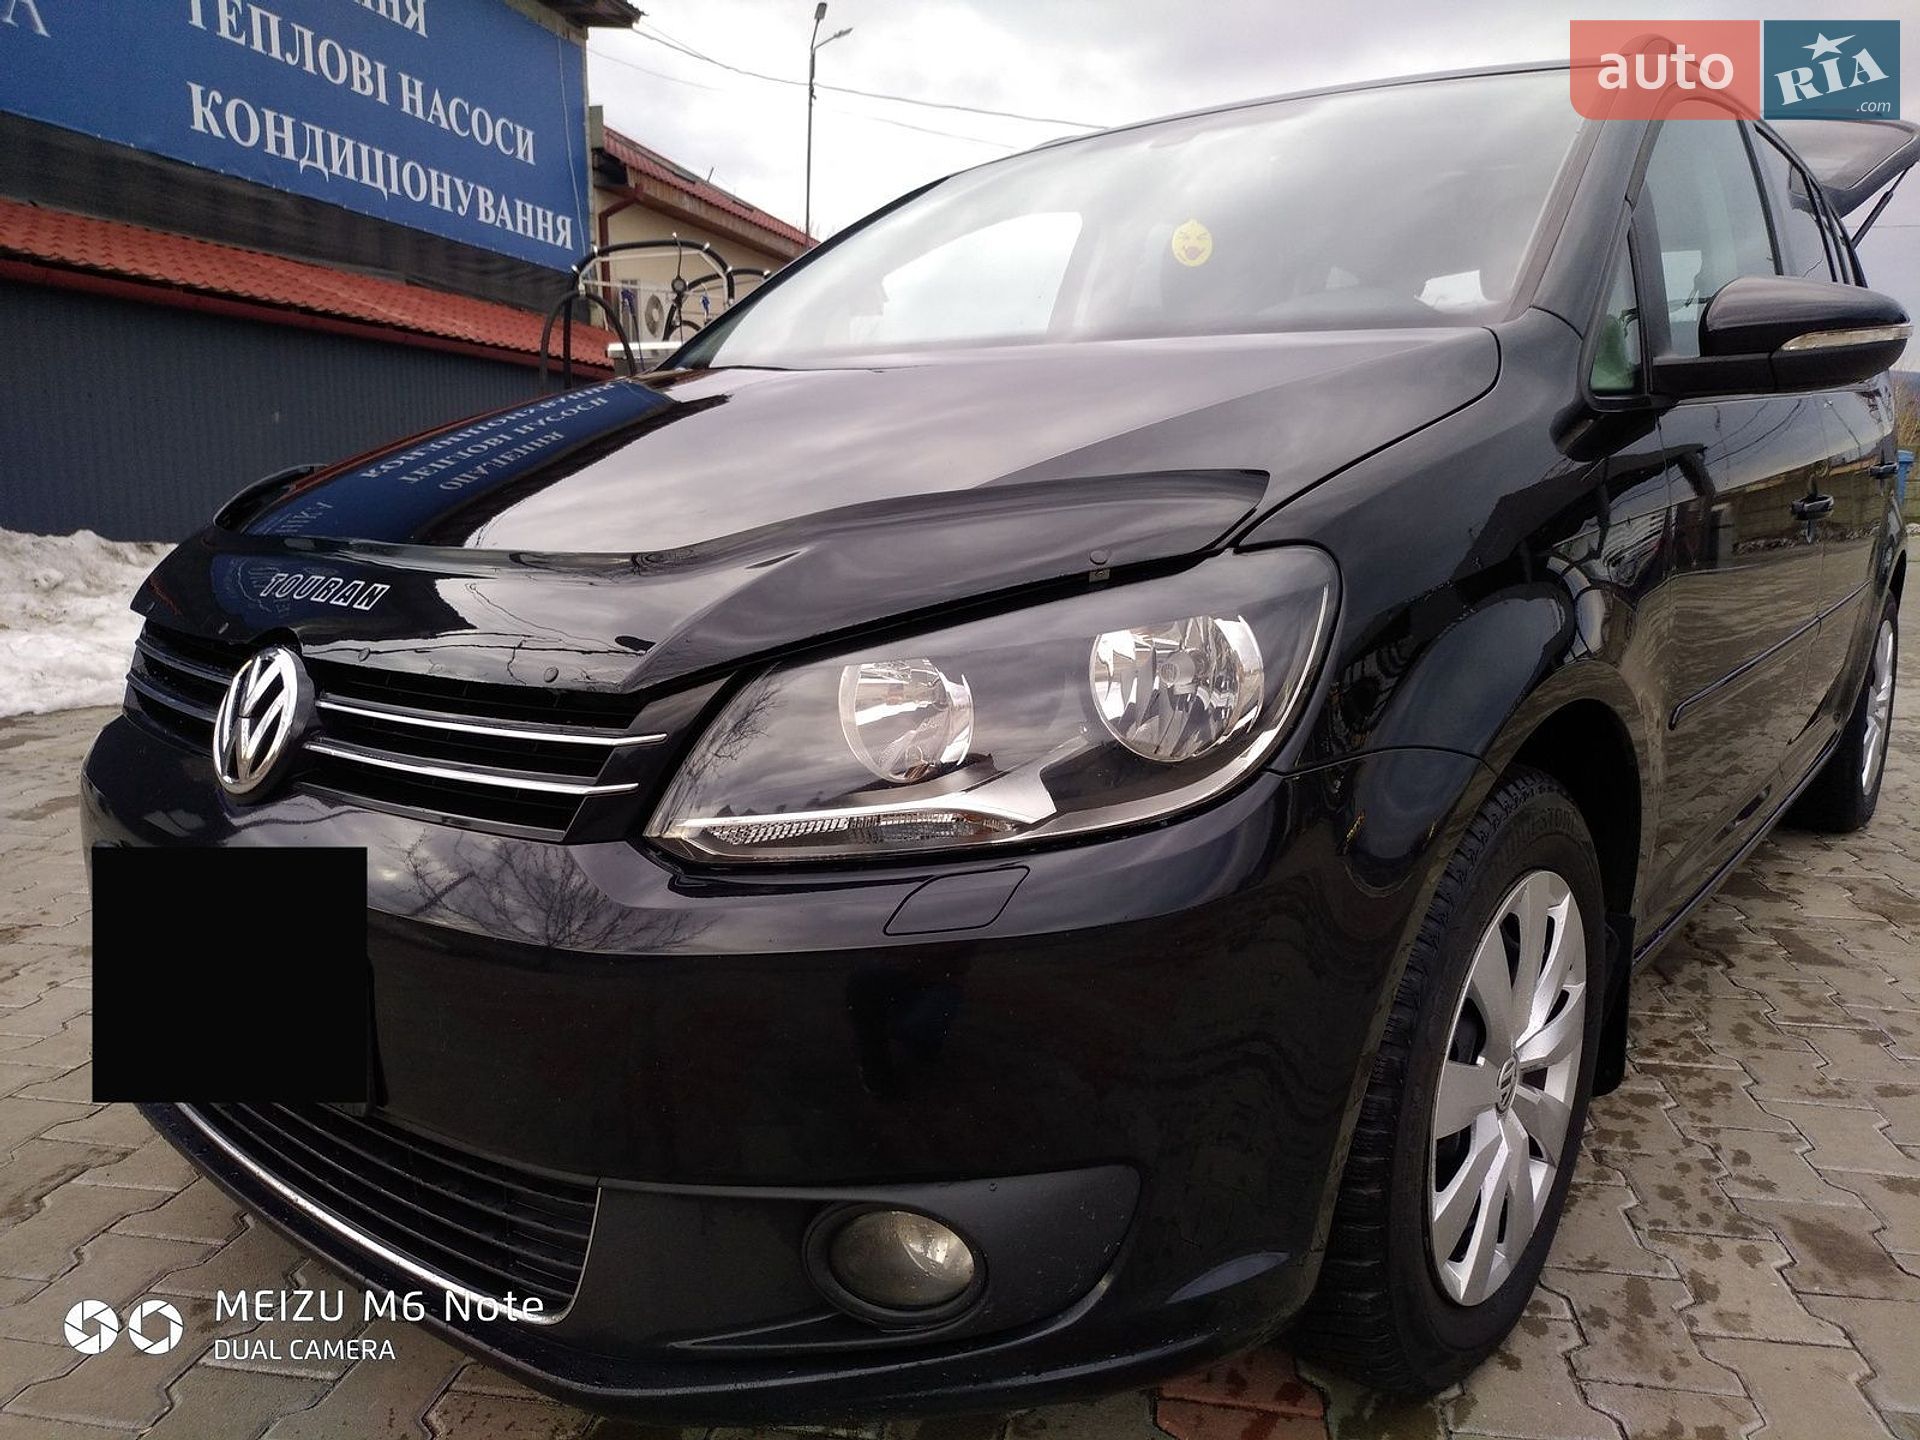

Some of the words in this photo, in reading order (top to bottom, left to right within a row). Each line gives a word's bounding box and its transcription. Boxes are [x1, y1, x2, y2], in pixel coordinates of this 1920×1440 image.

[399, 72, 536, 165] НАСОСИ
[187, 81, 573, 250] КОНДИЦІОНУВАННЯ
[260, 573, 391, 611] TOURAN
